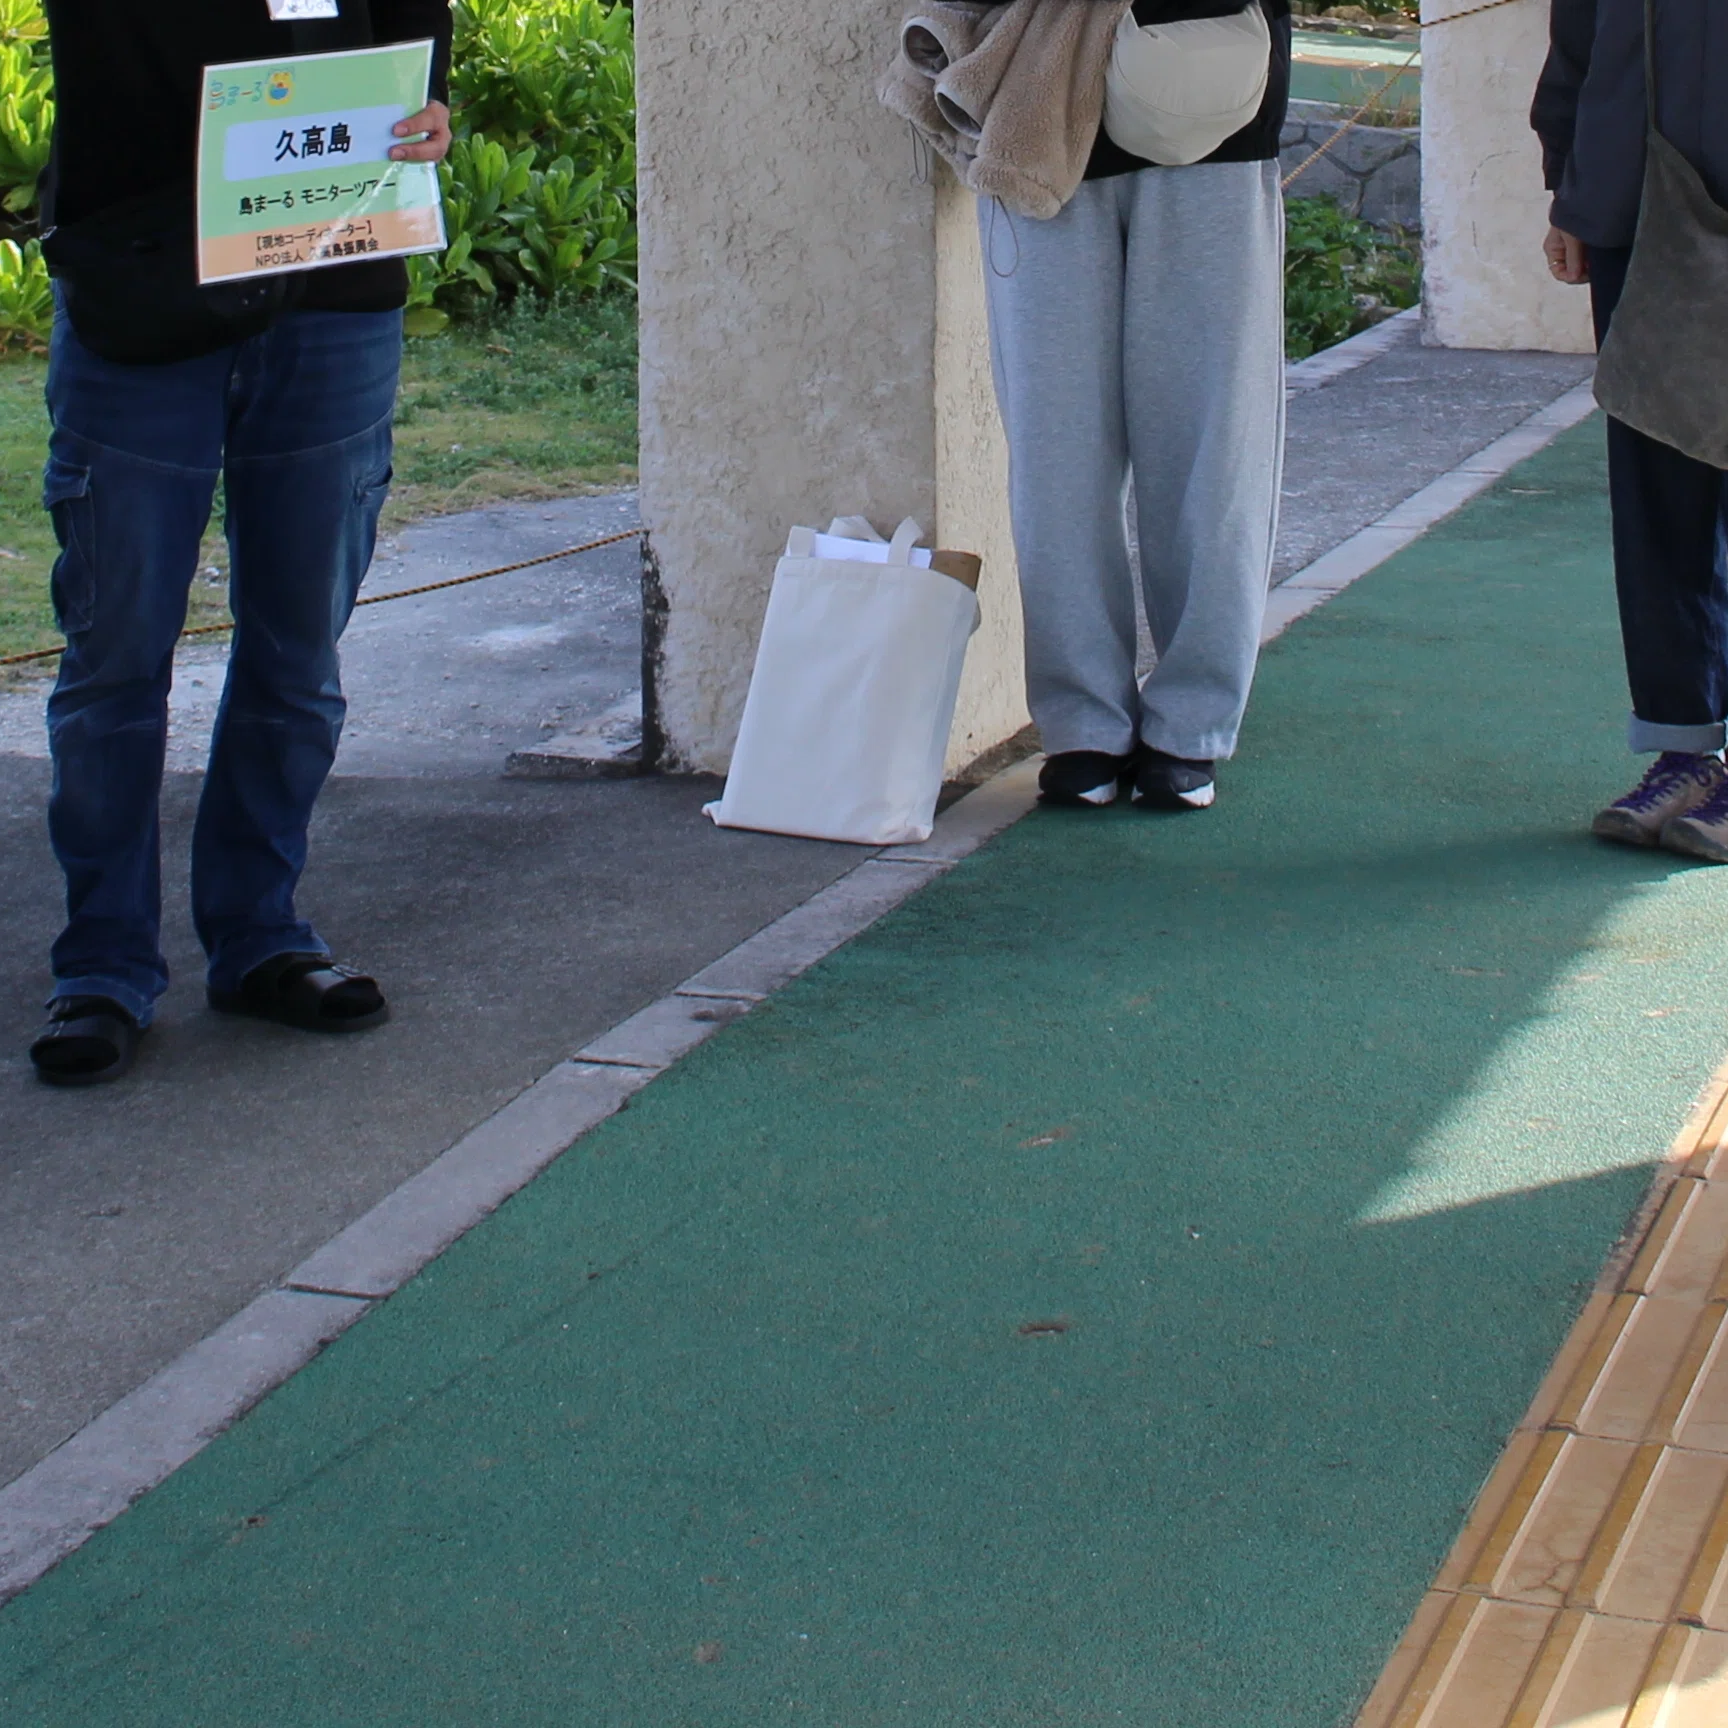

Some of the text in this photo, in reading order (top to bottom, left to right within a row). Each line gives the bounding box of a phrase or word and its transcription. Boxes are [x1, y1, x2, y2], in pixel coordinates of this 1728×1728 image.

[275, 122, 351, 161] 久高島
[239, 179, 396, 215] 島まーる モニターツアー
[256, 220, 372, 251] 【現地コーディーター】
[255, 251, 304, 268] NPO法人
